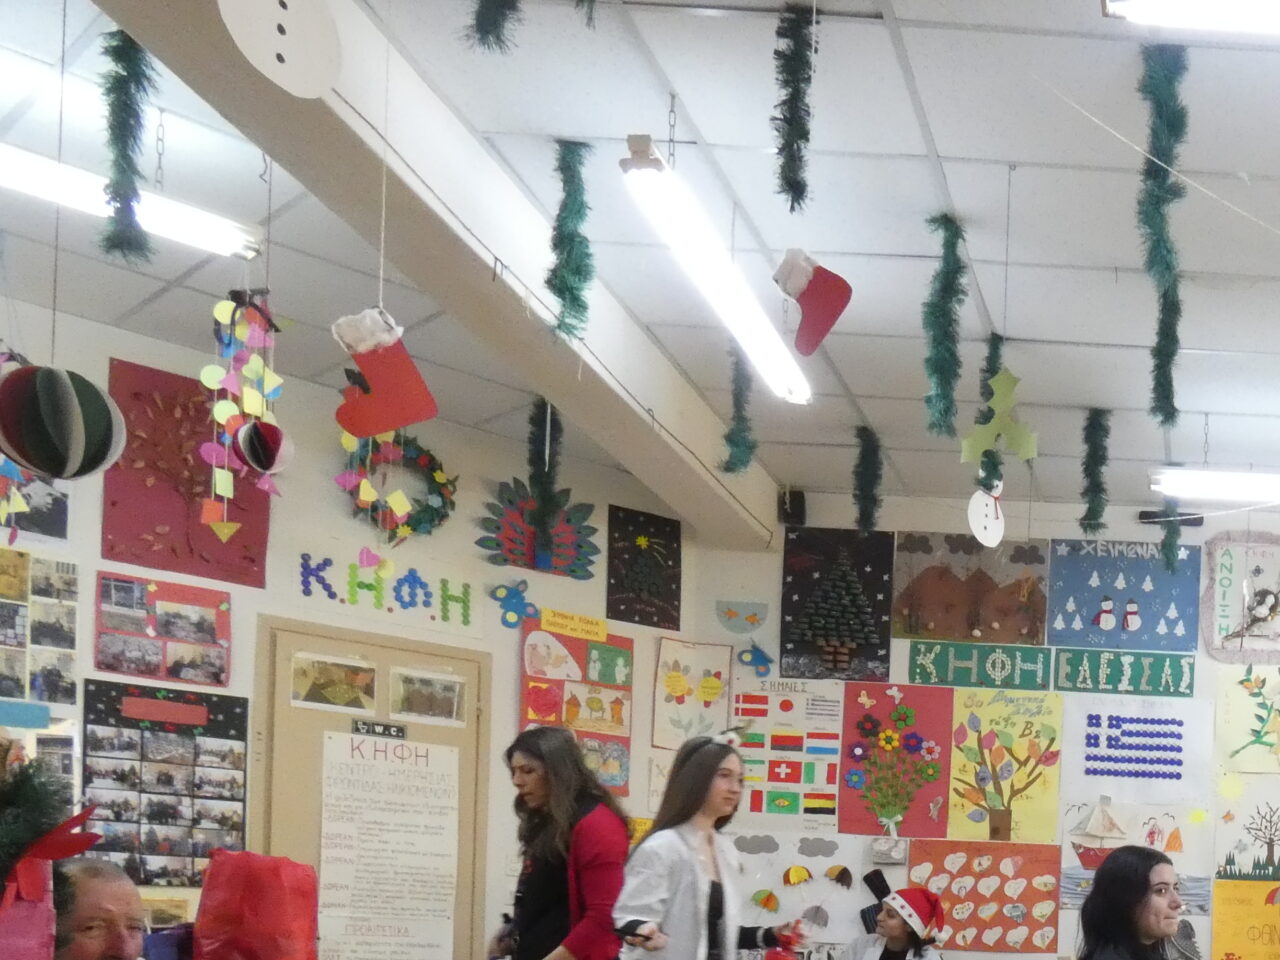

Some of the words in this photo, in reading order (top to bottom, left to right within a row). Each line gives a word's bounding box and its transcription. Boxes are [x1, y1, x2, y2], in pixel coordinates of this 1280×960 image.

[1079, 540, 1163, 560] ΧΕΙΜΩΝΑ
[915, 644, 1045, 685] ΚΗΦΗ
[1058, 652, 1194, 694] ΕΔΕΣΣΑΣ
[760, 681, 808, 693] ΣΗΜΑΙΕΣ
[373, 725, 403, 737] W.C.
